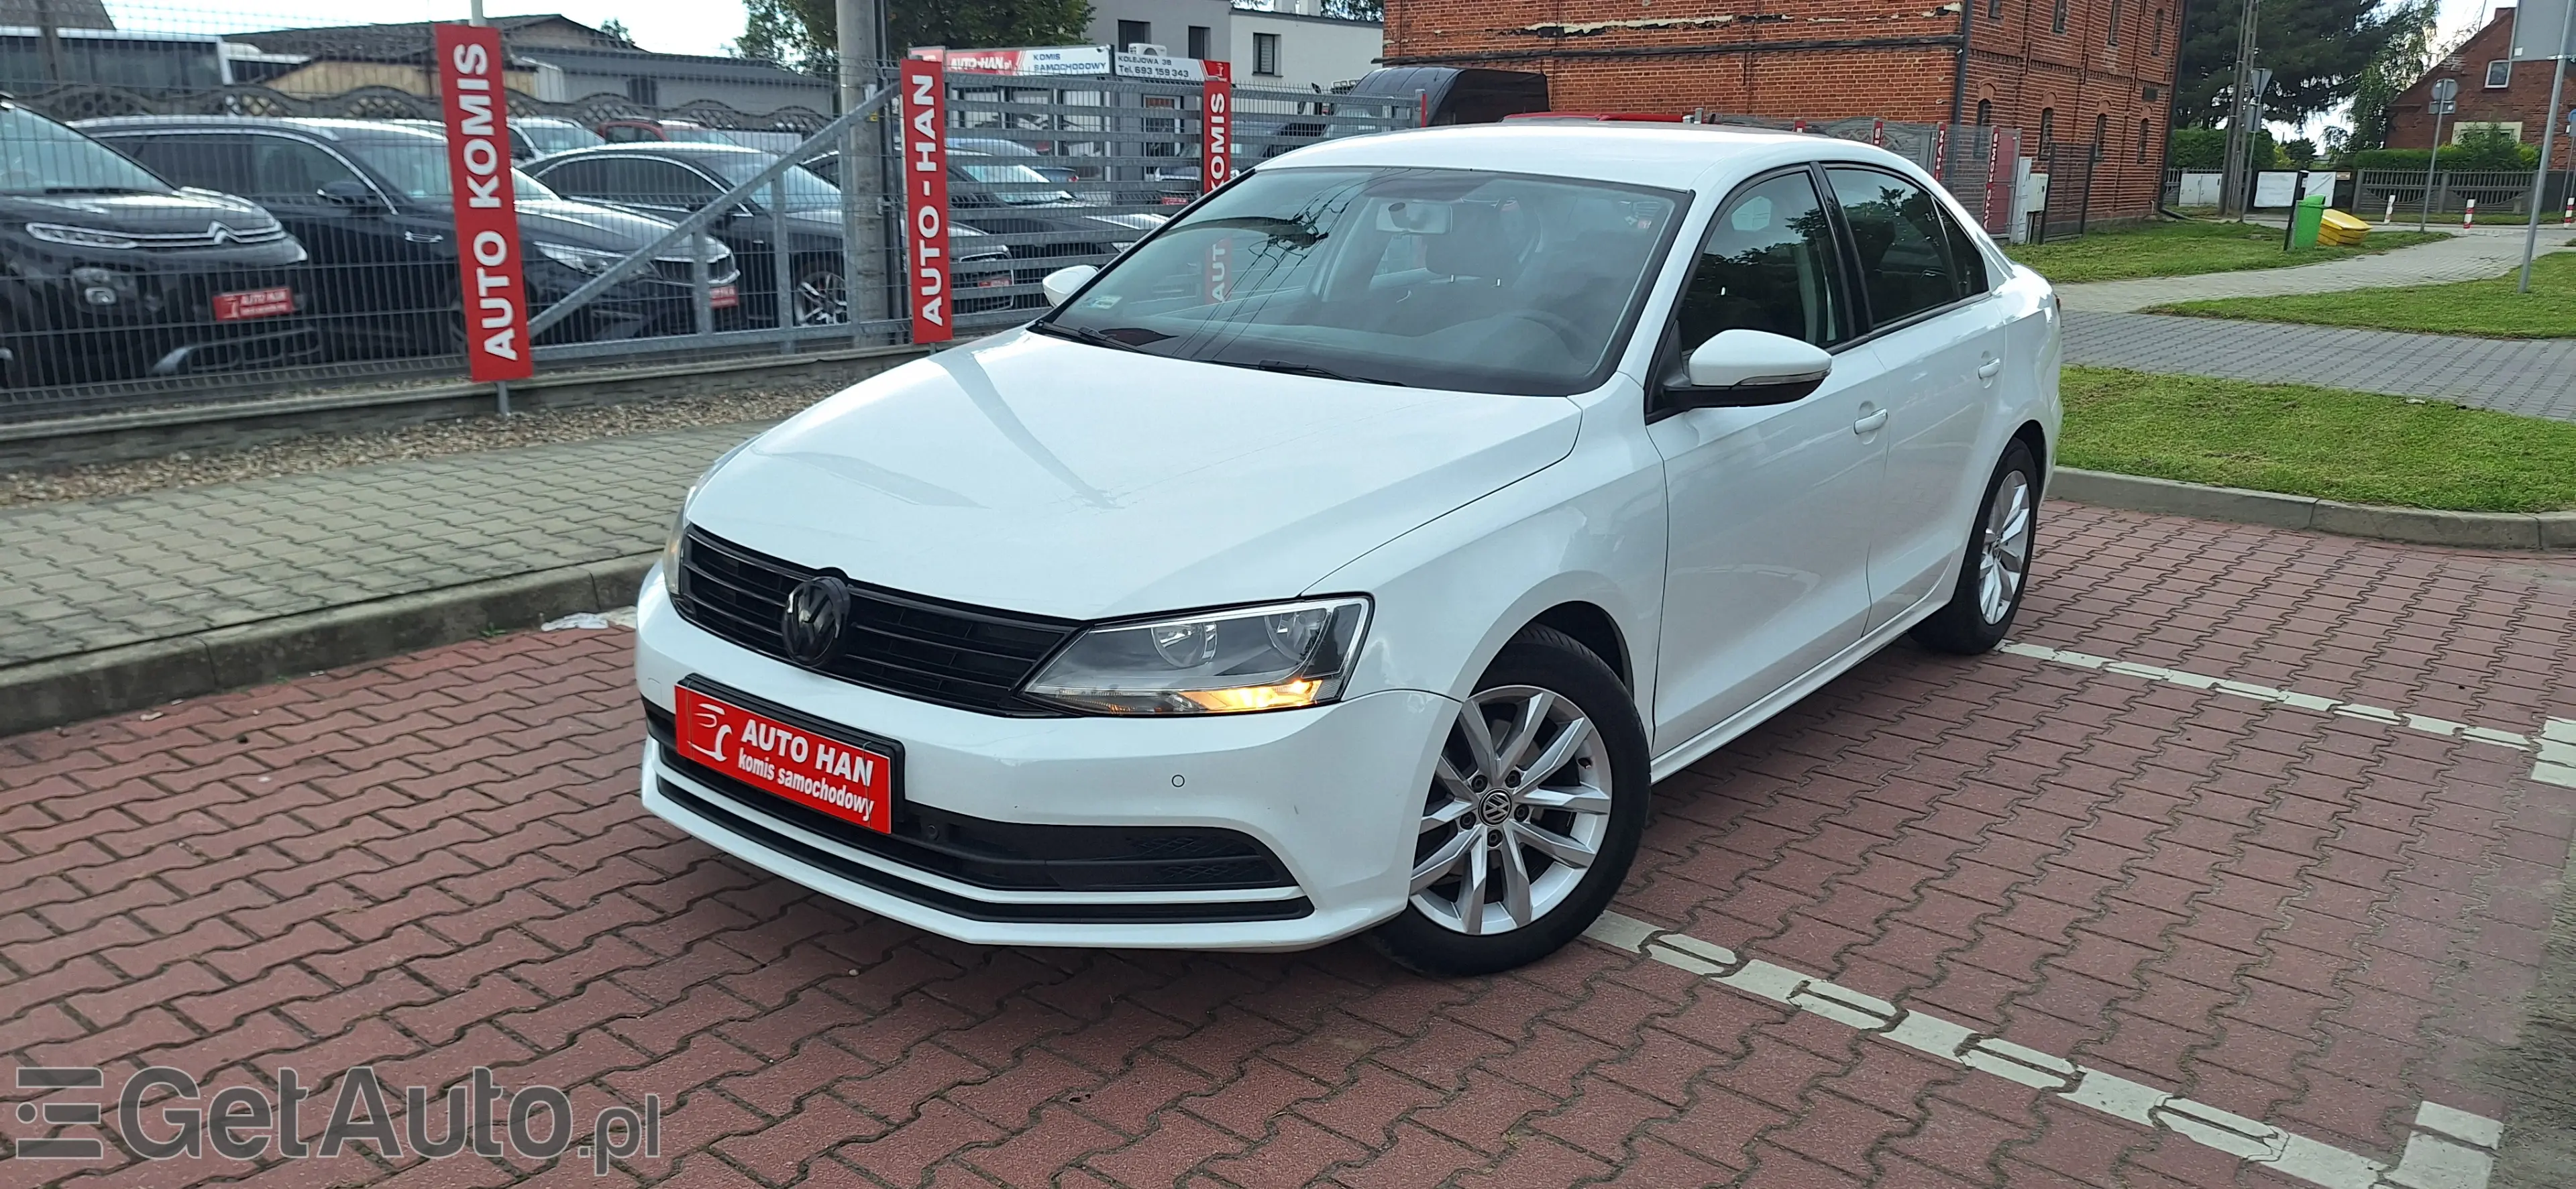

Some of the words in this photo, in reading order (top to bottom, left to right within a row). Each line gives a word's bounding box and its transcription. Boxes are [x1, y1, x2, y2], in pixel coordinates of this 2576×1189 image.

[1033, 53, 1061, 61] KOMIS
[1034, 62, 1107, 72] SAMOCHODOWY
[1118, 56, 1159, 65] KOLEJOWA
[1134, 66, 1152, 74] 693
[1155, 68, 1171, 76] 159
[1172, 69, 1189, 78] 343
[453, 42, 502, 209] KOMIS
[472, 230, 518, 361] AUTO
[1212, 243, 1226, 303] AUT
[740, 718, 809, 764] AUTO
[814, 743, 874, 787] HAN
[738, 748, 775, 781] komis
[776, 767, 875, 822] samochodowy
